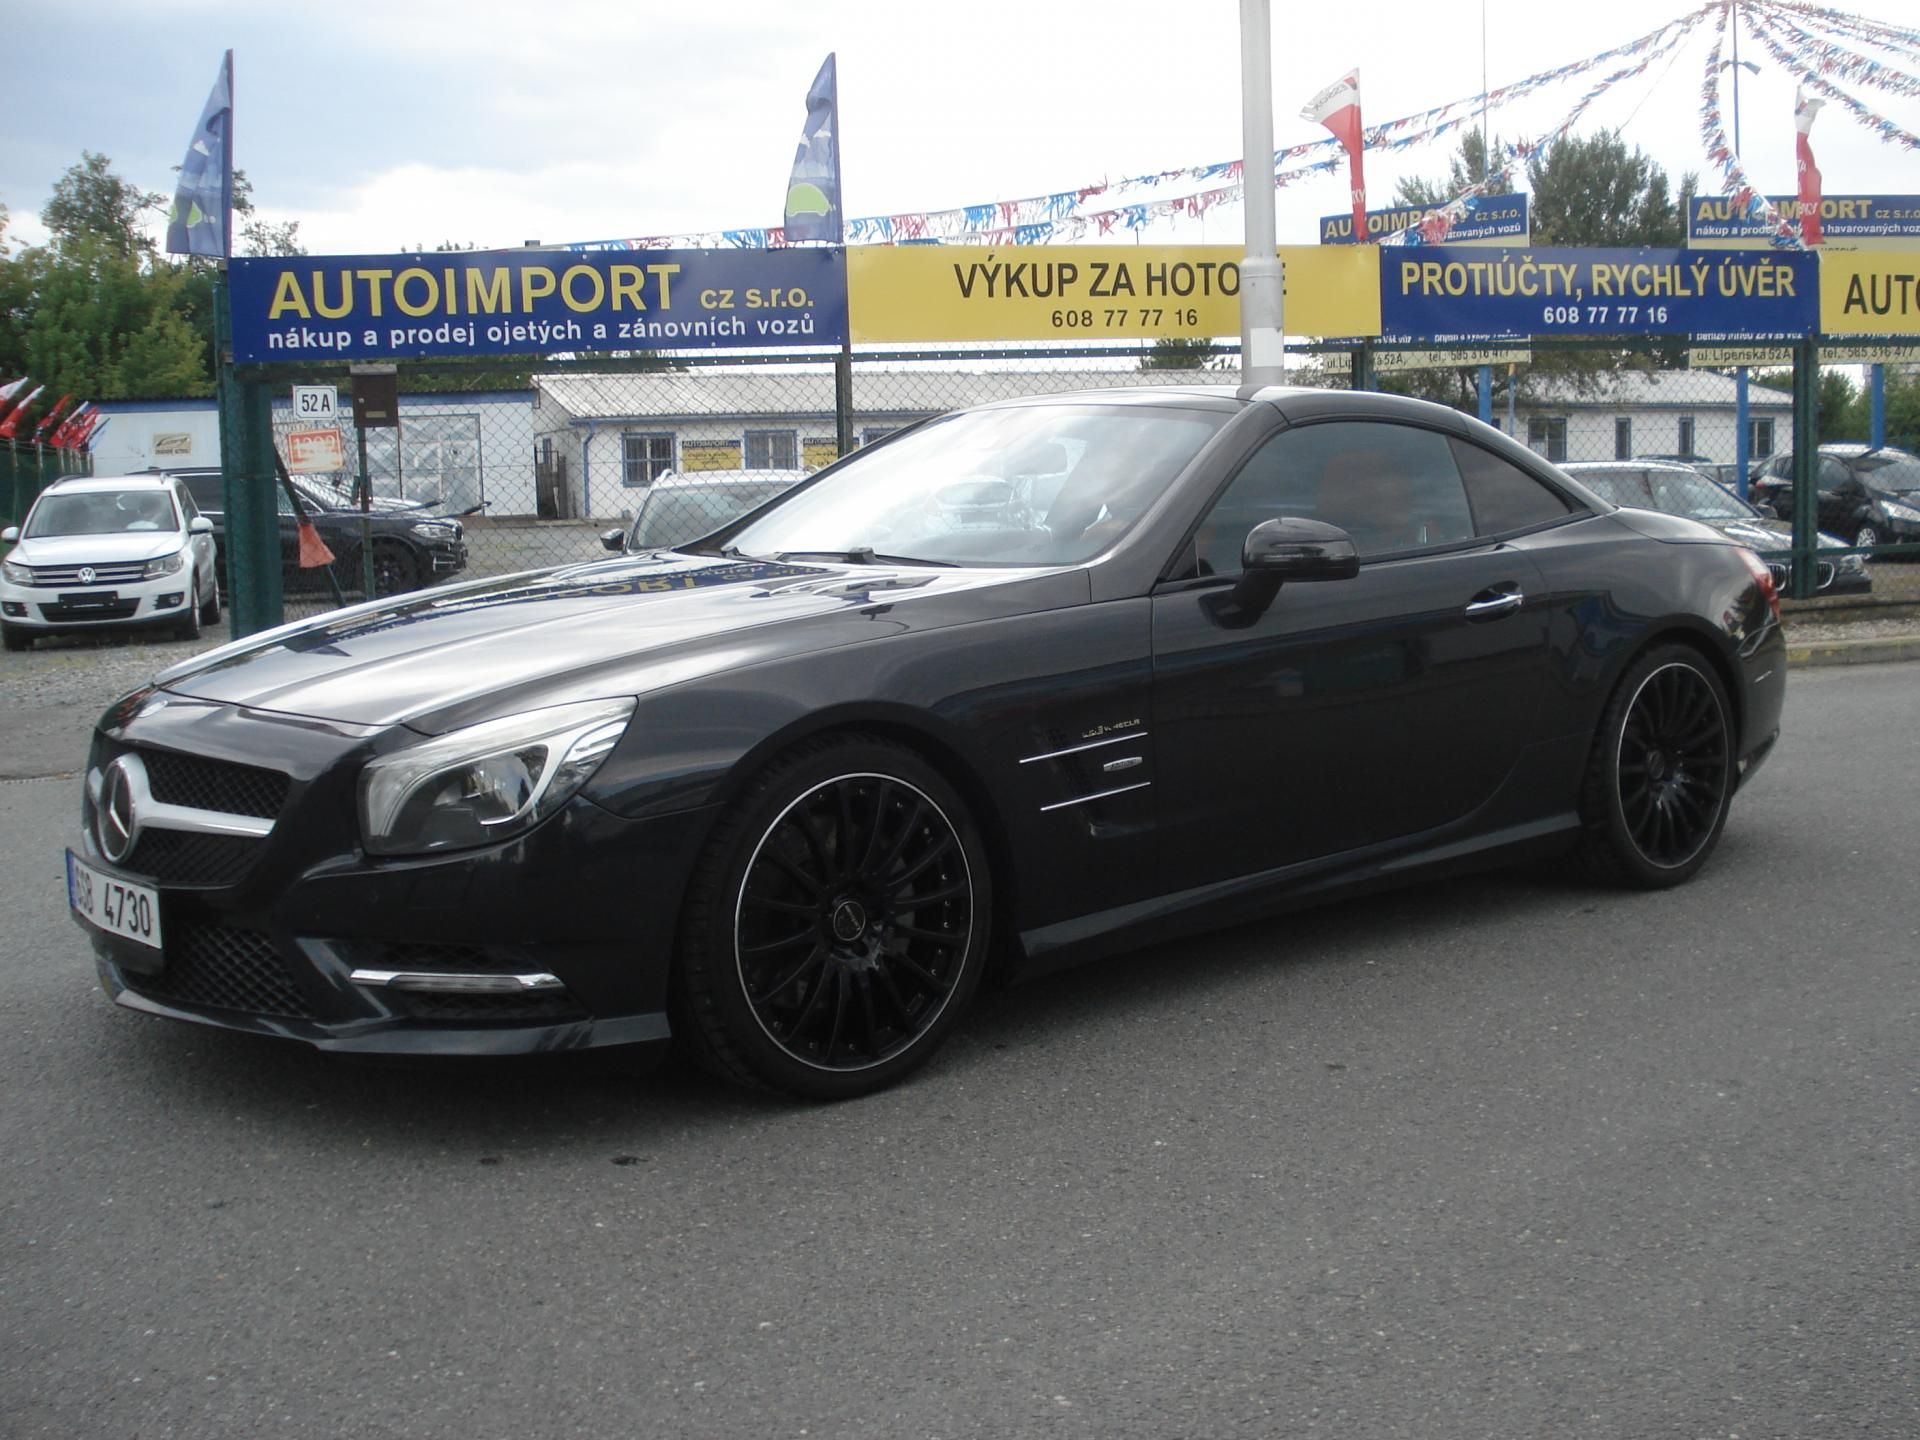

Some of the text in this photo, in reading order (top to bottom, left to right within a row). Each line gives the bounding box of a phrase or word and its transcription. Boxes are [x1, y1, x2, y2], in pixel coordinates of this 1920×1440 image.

[1828, 223, 1900, 235] havarovaných
[1903, 224, 1920, 233] voz
[268, 263, 814, 320] AUTOIMPORT cz s.r.o.
[953, 254, 1078, 299] VÝKUP
[1089, 262, 1136, 297] ZA
[1401, 253, 1796, 302] PROTIÚČTY, RYCHLÝ ÚVĚR
[1843, 273, 1920, 315] AUT
[268, 312, 815, 351] nákup a prodej ojetých a zánovních vozů
[1052, 308, 1198, 328] 608 77 77 16
[1543, 306, 1668, 324] 608 77 77 16
[104, 882, 151, 937] 4730
